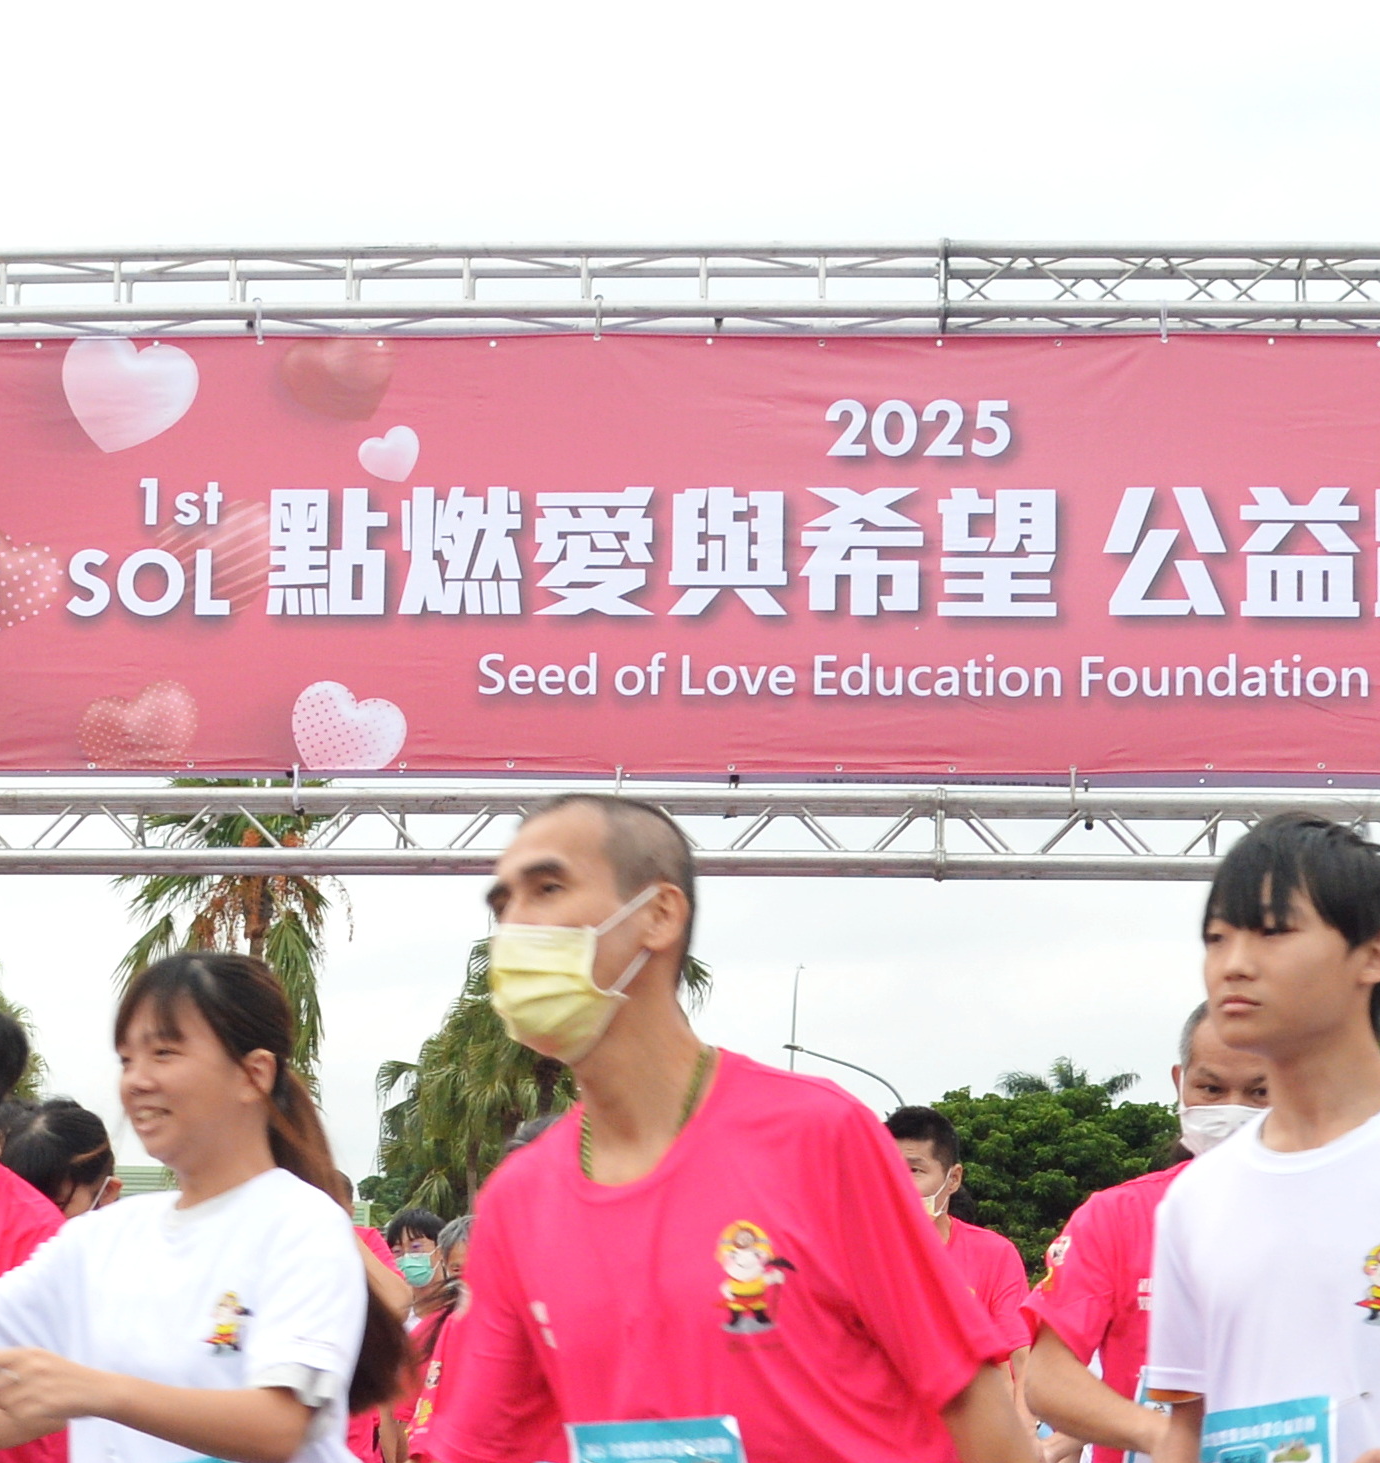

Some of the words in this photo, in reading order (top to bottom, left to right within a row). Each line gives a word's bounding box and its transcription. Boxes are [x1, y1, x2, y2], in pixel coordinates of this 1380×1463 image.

[824, 398, 1012, 459] 2025
[139, 477, 223, 526] 1st
[266, 486, 1058, 618] 點燃愛與希望
[66, 548, 231, 618] SOL
[477, 652, 597, 696] Seed
[614, 652, 667, 696] of
[681, 655, 797, 698] Love
[814, 655, 1062, 699] Education
[1081, 655, 1370, 700] Foundation
